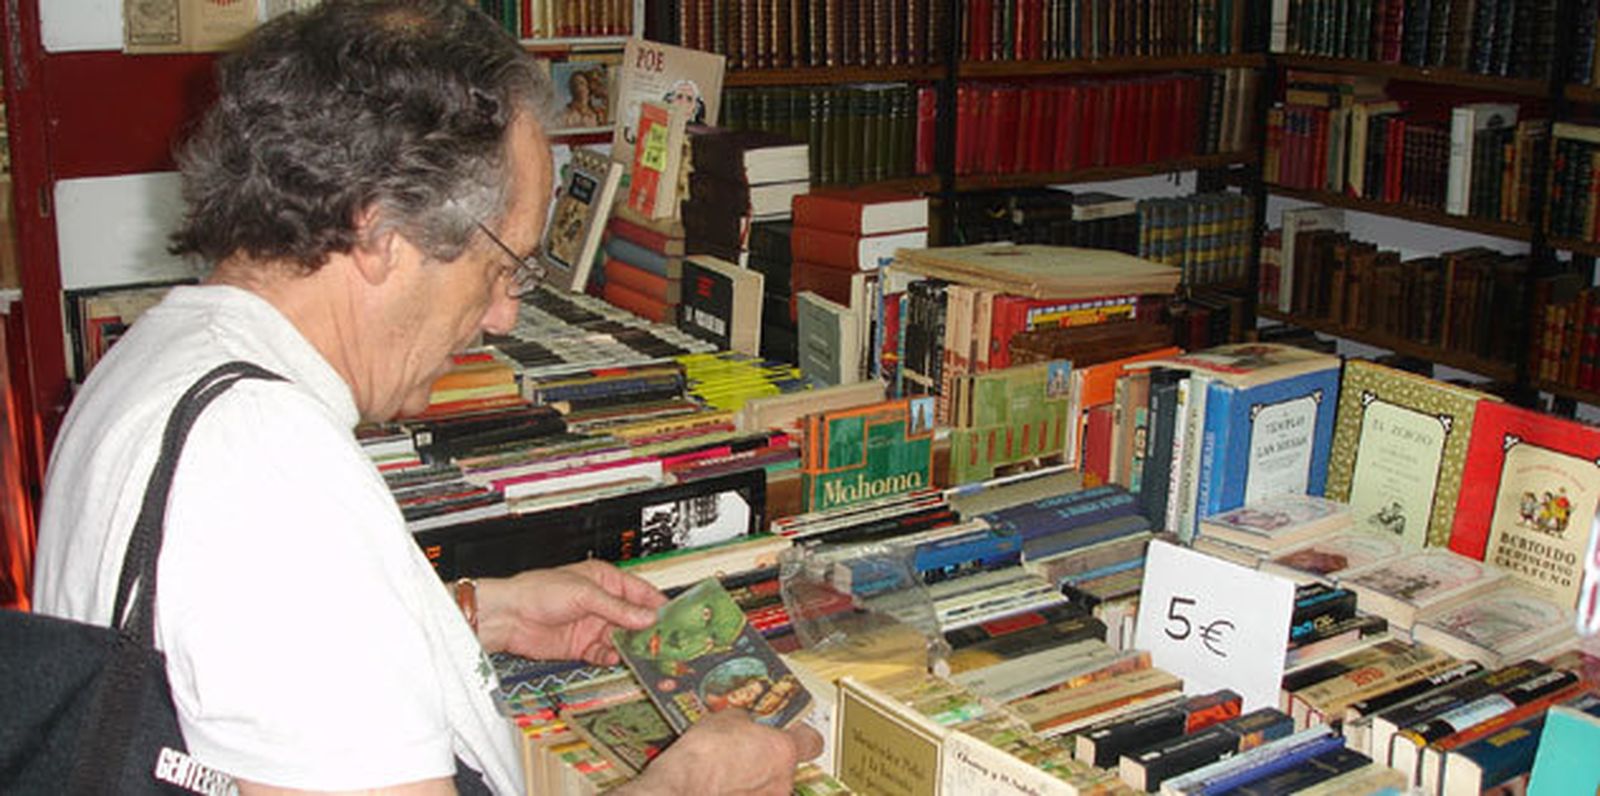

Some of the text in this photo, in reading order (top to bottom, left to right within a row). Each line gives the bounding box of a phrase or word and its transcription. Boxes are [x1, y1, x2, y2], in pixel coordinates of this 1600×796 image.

[635, 48, 665, 72] POE
[823, 472, 922, 508] Mahoma
[1500, 532, 1577, 566] BERTOLDO
[1164, 596, 1236, 658] 5€
